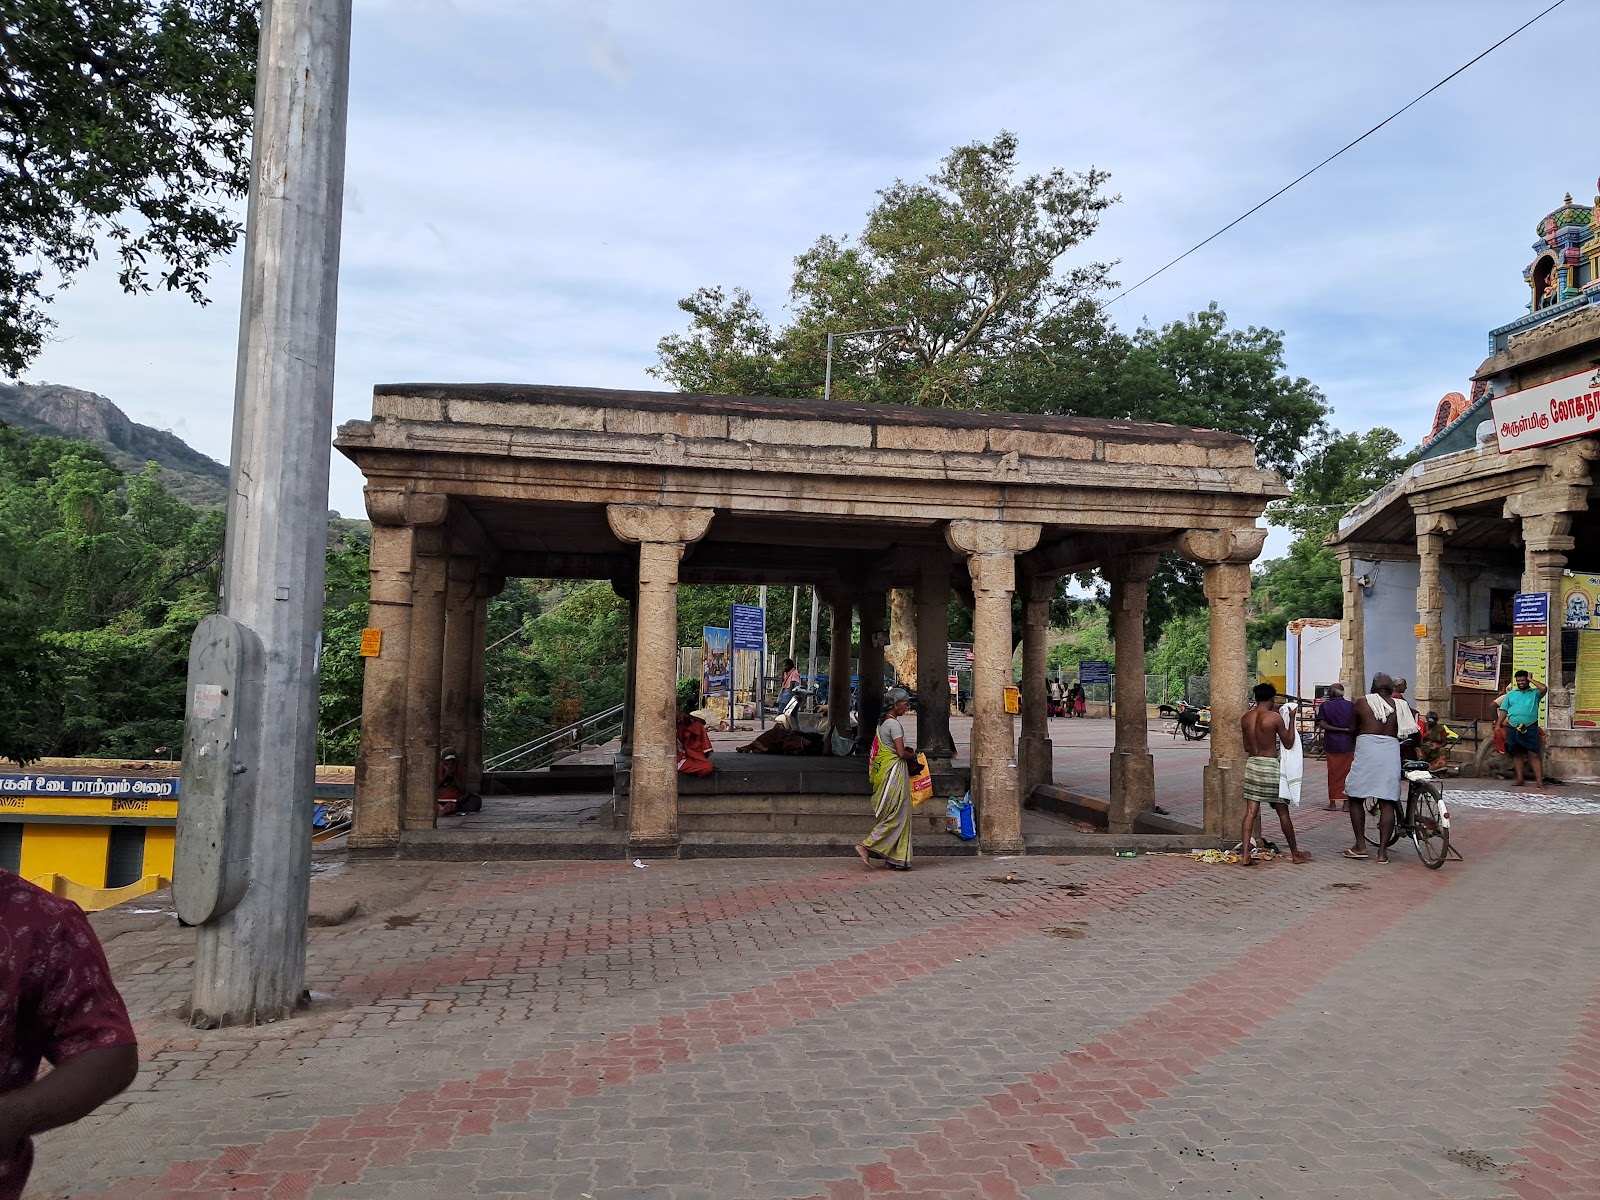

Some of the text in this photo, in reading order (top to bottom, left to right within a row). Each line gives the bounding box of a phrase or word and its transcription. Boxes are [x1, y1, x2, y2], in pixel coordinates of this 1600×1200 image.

[1500, 411, 1549, 438] அருள்மிகு
[0, 776, 172, 797] கள் உடை மாற்றும் அறை
